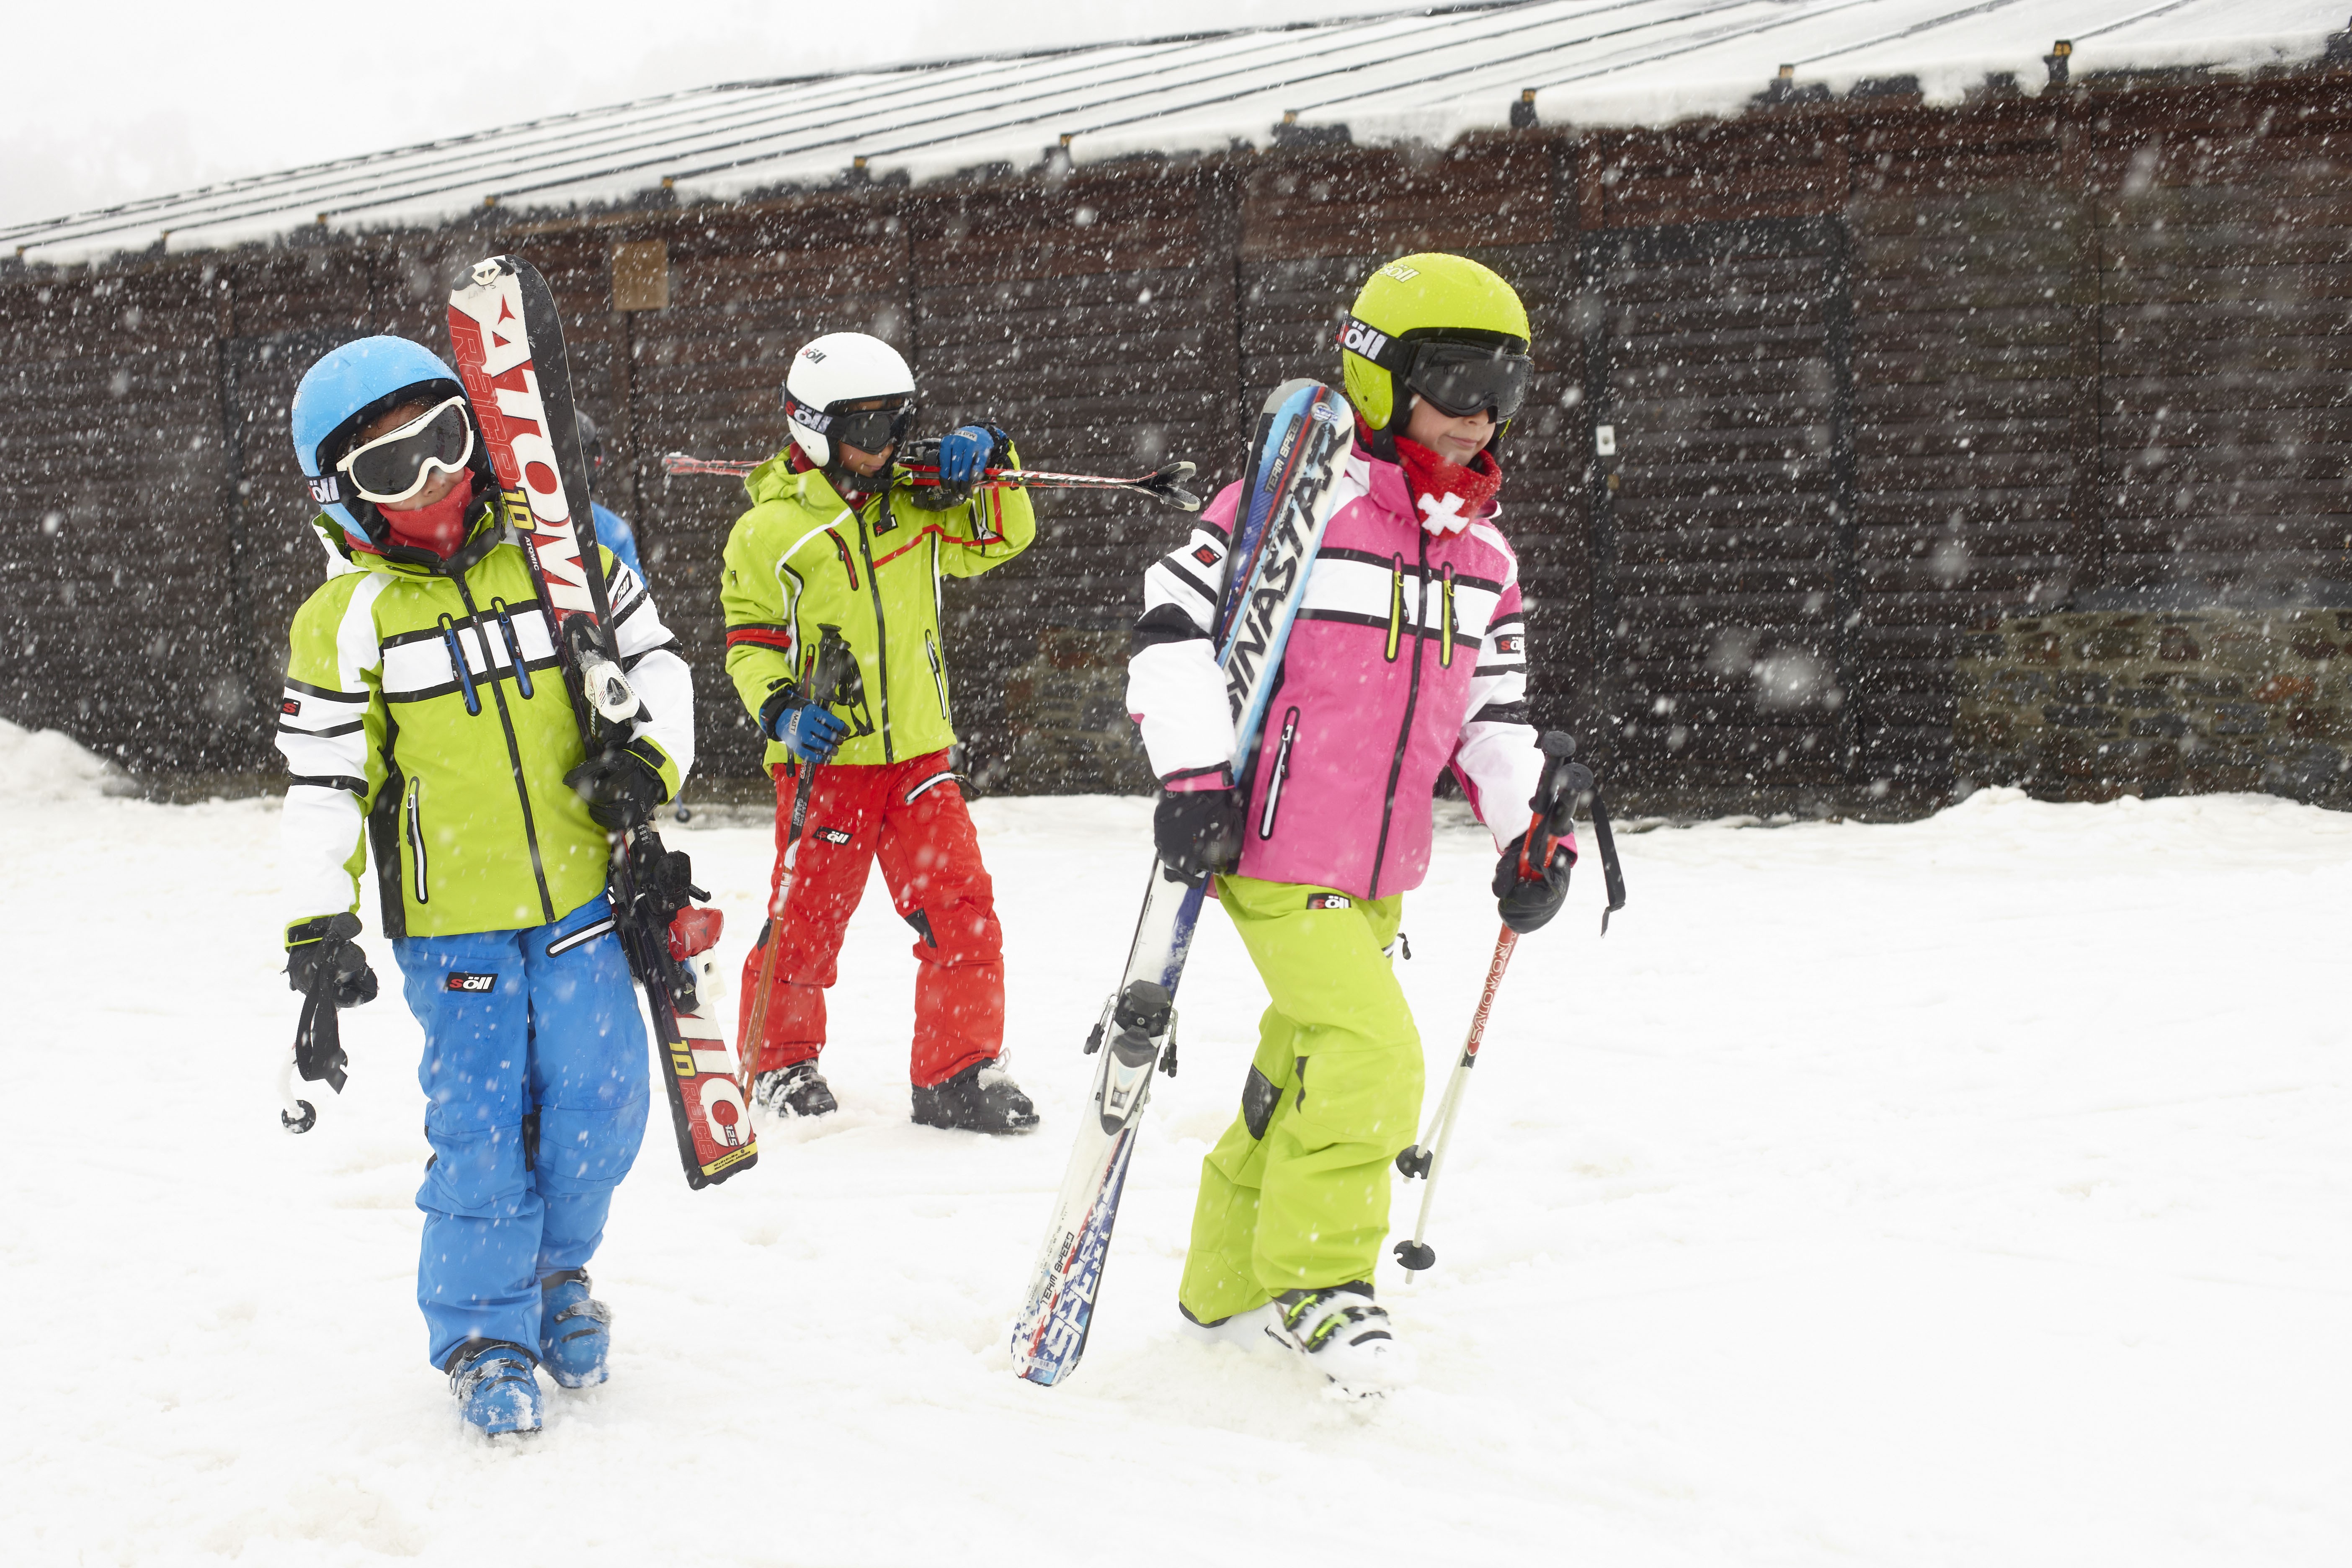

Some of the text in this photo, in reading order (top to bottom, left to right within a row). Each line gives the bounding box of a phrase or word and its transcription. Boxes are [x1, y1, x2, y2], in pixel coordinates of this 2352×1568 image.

[1379, 264, 1421, 283] söll
[802, 348, 827, 364] söll
[785, 400, 833, 433] söll
[480, 291, 596, 613] ATOM
[1265, 417, 1302, 493] TEAM SPEED
[503, 490, 535, 530] 10
[524, 536, 539, 571] ATOMIC
[790, 713, 799, 732] MATT
[818, 830, 849, 843] söll
[1311, 895, 1349, 909] söll
[449, 976, 493, 990] söll
[1469, 941, 1511, 1044] SALOMON
[669, 1039, 696, 1077] 10
[725, 1125, 738, 1146] 125
[1040, 1274, 1057, 1305] TEAM
[1054, 1231, 1075, 1273] SPEED
